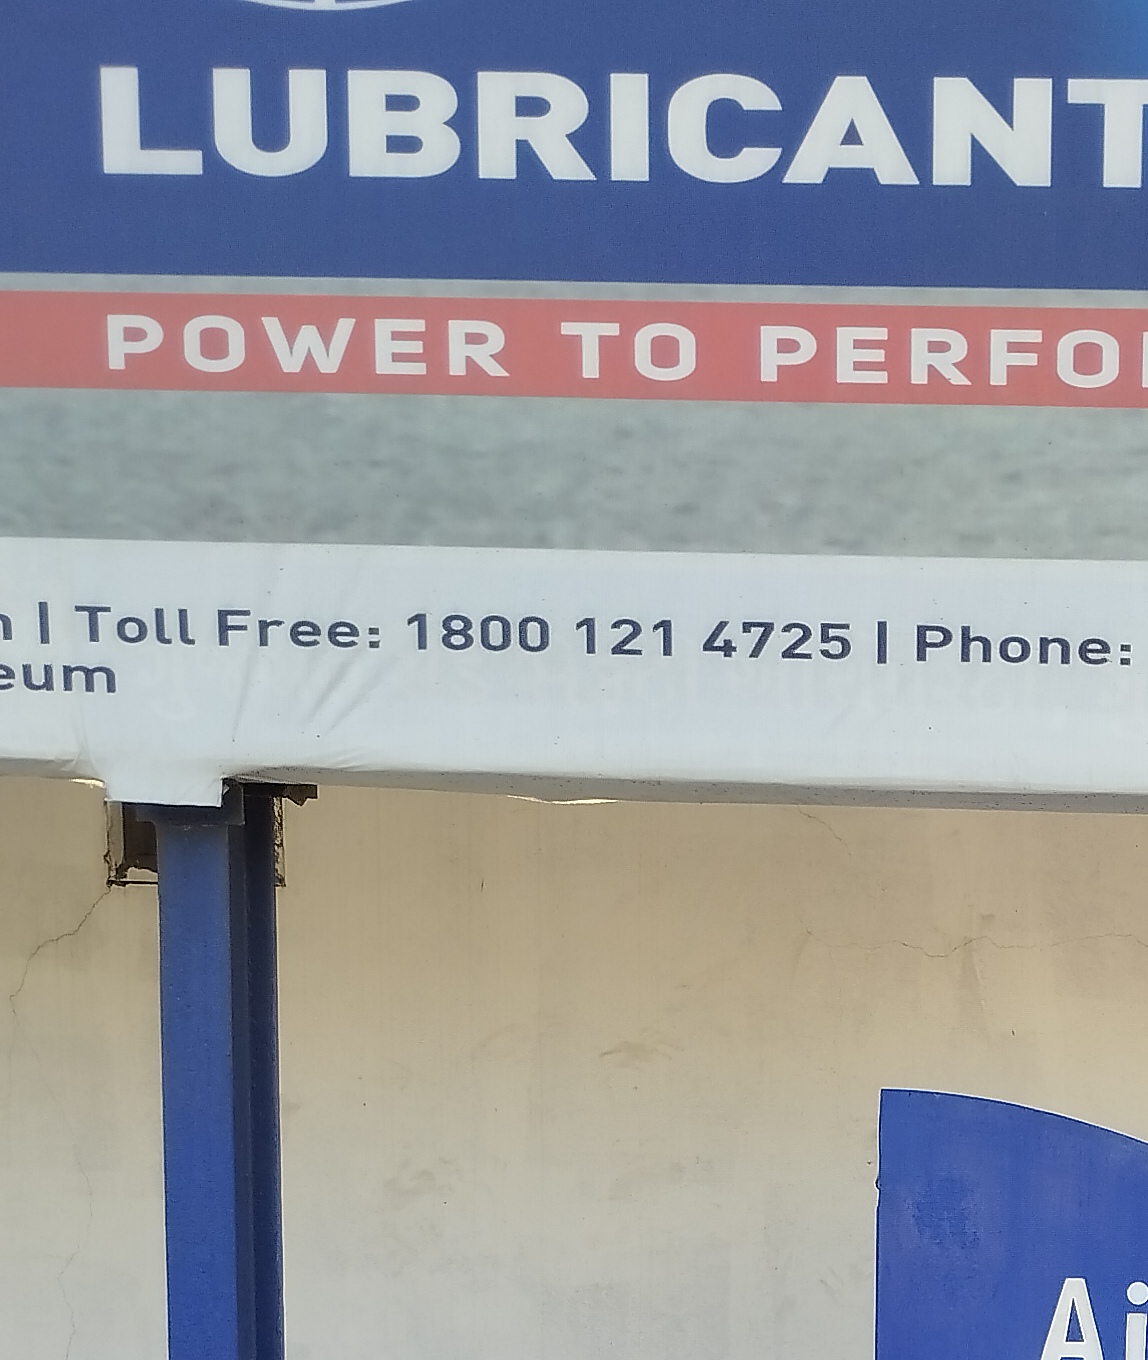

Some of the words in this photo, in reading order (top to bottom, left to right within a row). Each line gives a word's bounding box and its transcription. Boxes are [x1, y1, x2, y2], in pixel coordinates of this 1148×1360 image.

[106, 314, 509, 377] POWER
[561, 321, 697, 381] TO
[75, 605, 193, 646] Toll
[217, 609, 381, 649] Free:
[407, 612, 550, 652] 1800
[575, 617, 674, 658] 121
[703, 620, 852, 661] 4725
[915, 624, 1133, 667] Phone:
